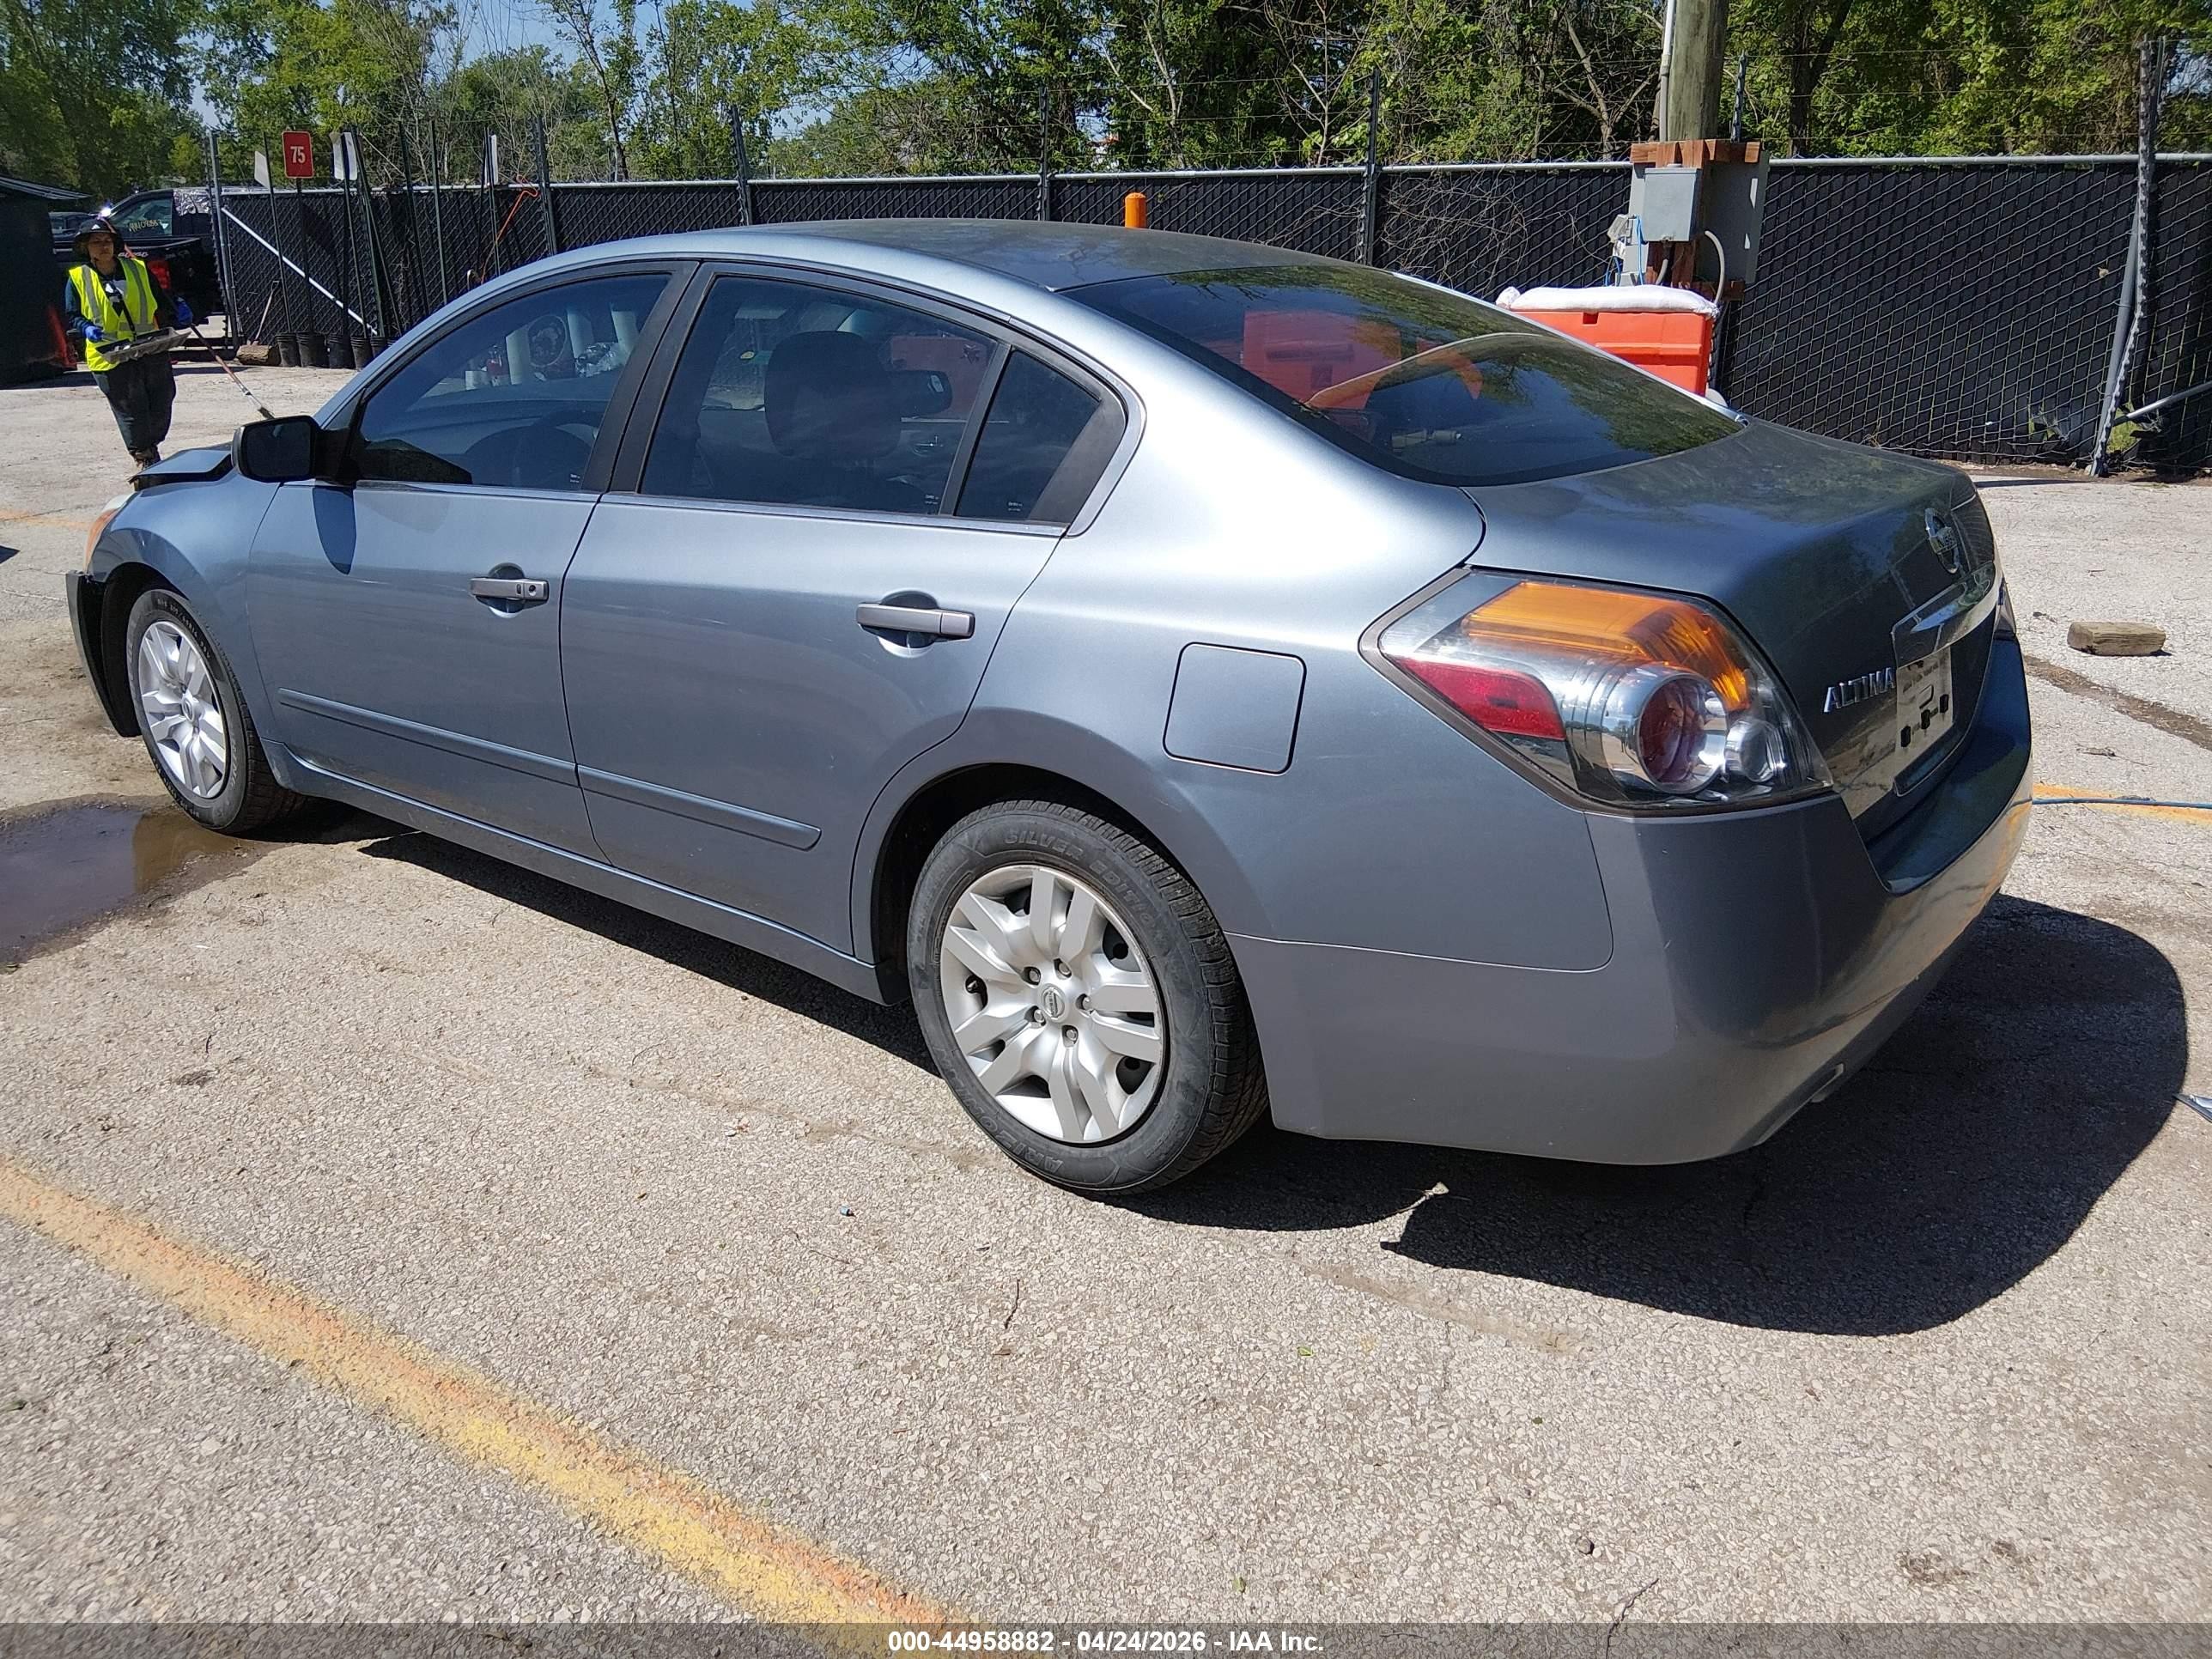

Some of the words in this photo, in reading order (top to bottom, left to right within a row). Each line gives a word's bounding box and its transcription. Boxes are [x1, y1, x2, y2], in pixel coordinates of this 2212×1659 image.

[290, 146, 306, 164] 75
[1824, 667, 1896, 712] ALTIMA
[1005, 830, 1085, 860] SILVER
[1089, 859, 1166, 946] EDITIO
